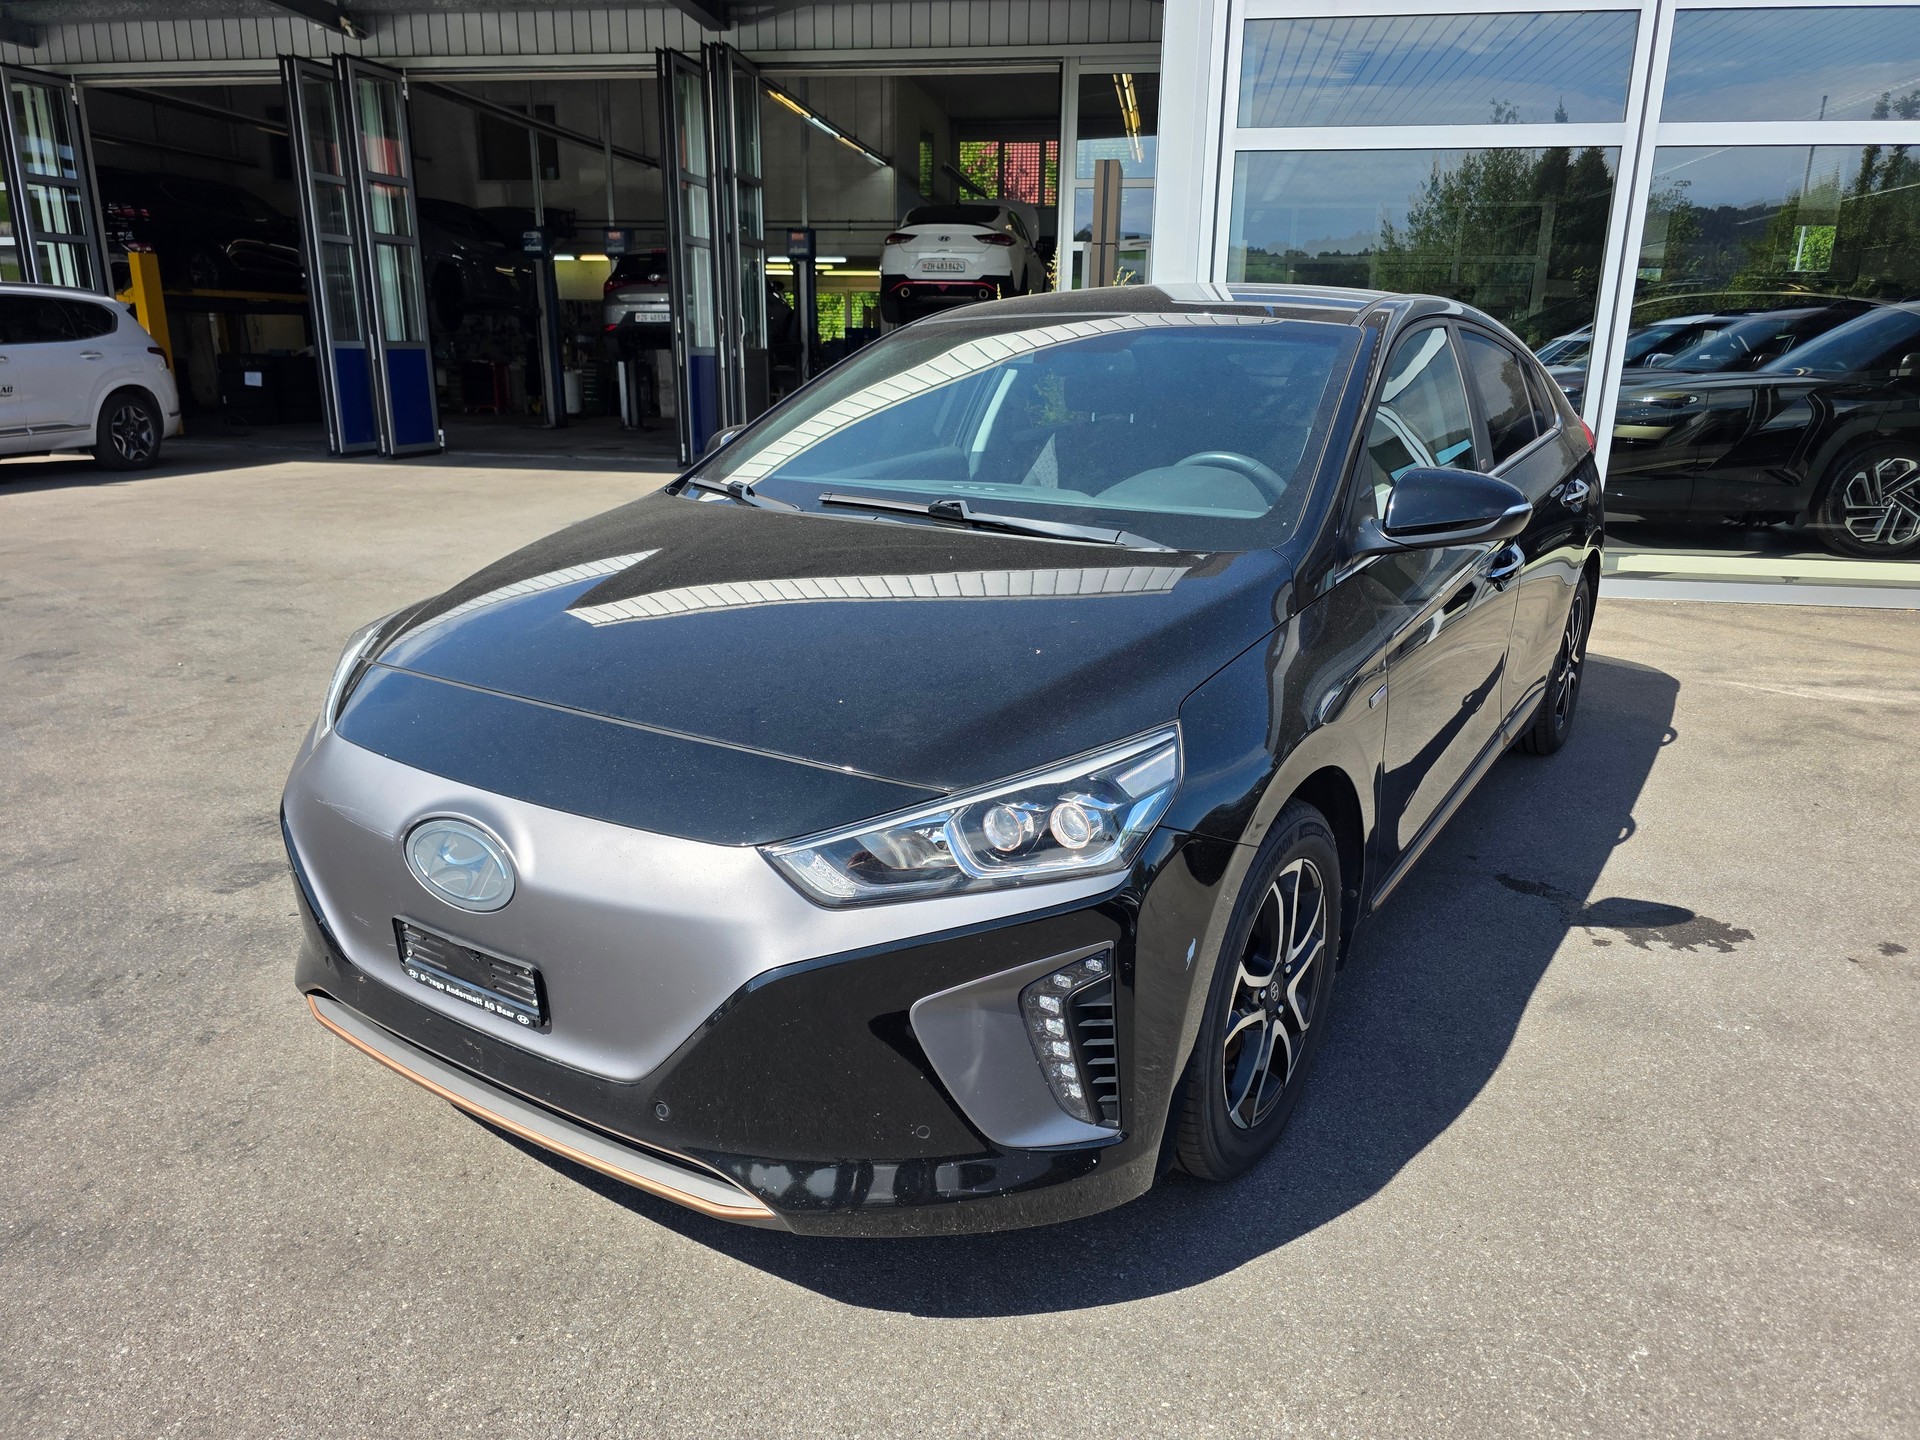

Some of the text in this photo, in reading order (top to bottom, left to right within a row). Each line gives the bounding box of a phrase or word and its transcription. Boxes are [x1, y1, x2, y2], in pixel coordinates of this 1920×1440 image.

[445, 984, 483, 1006] Andermatt
[484, 1000, 495, 1011] AG
[496, 1005, 515, 1019] Baar
